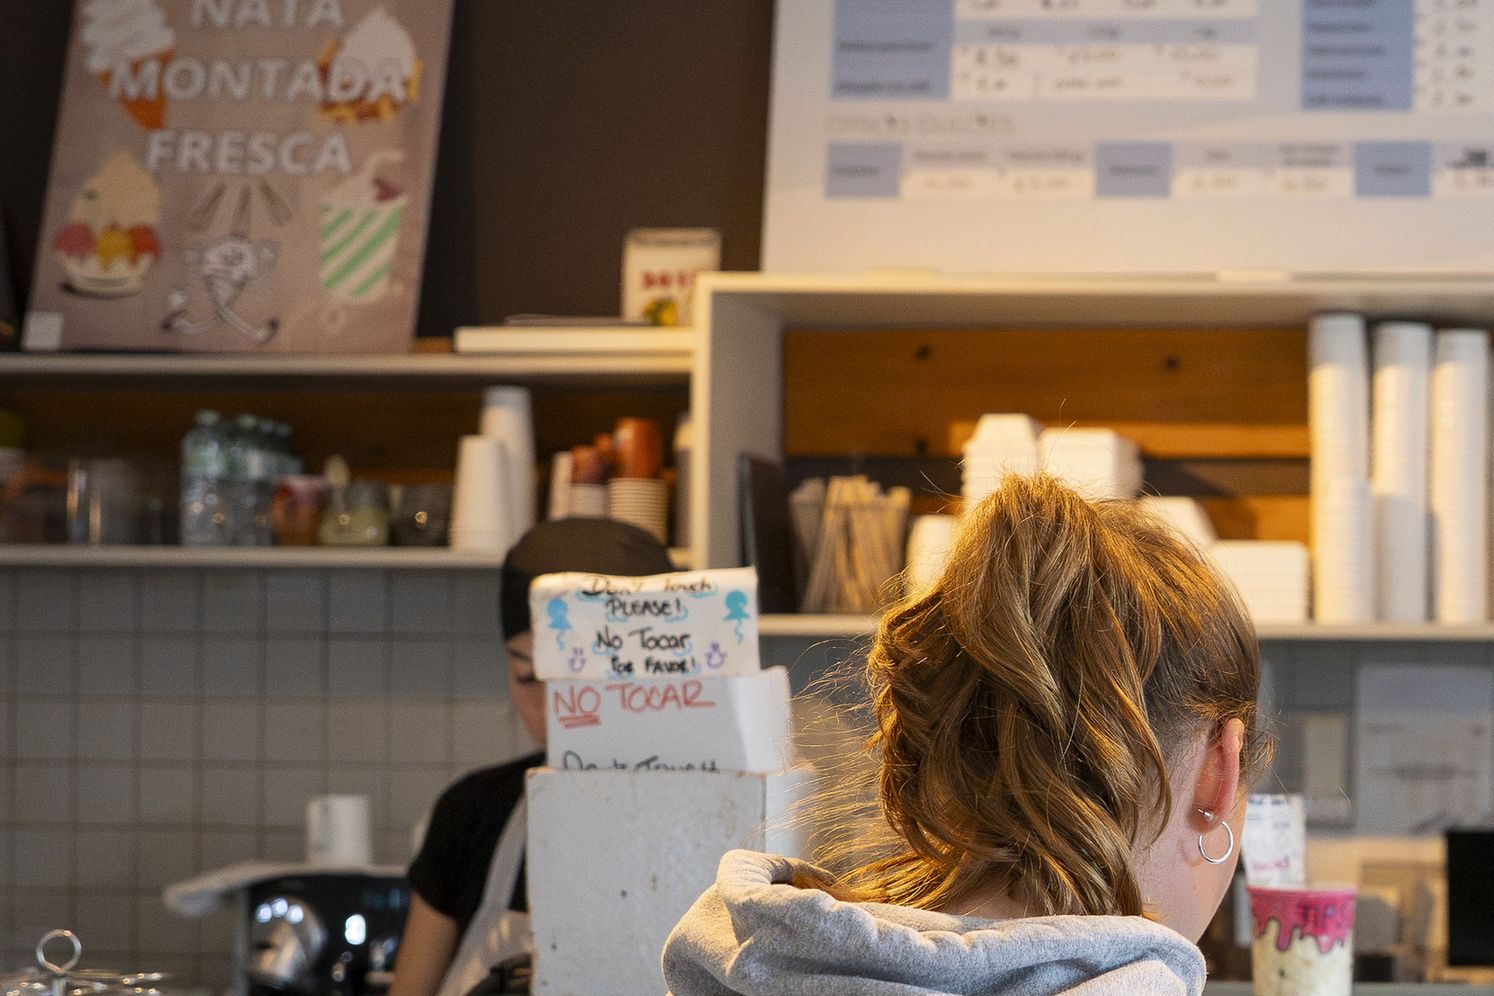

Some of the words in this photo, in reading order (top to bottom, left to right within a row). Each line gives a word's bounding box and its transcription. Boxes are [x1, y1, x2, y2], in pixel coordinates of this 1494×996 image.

[189, 0, 343, 27] NATA
[113, 57, 407, 100] MONTADA
[145, 129, 352, 175] FRESCA
[605, 597, 681, 617] PLEASE!
[596, 625, 623, 649] No
[628, 626, 691, 649] Tocar
[553, 685, 601, 716] NO
[605, 680, 716, 713] TOCAR
